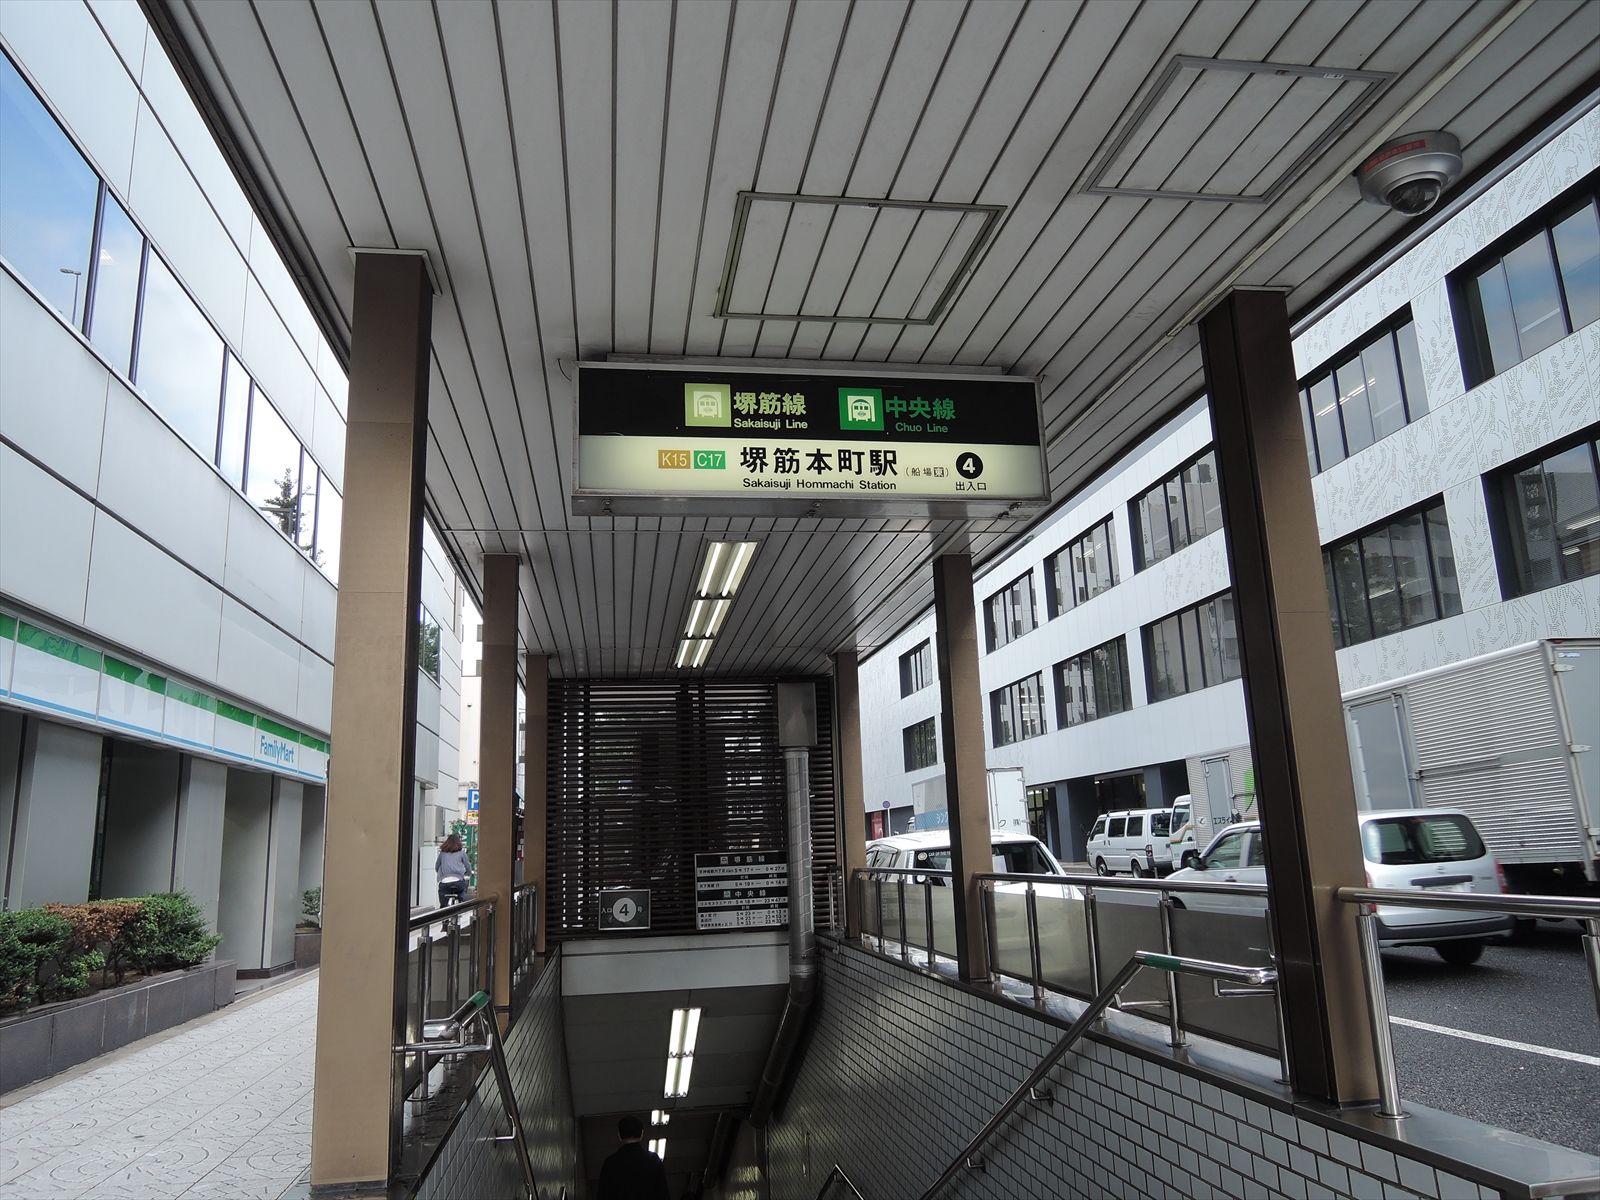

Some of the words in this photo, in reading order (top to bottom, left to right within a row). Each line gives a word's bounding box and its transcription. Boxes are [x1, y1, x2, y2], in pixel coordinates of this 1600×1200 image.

[733, 391, 807, 415] 堺筋線
[885, 396, 956, 419] 中央線
[734, 418, 781, 430] Sakaisuji
[786, 419, 808, 429] Line
[895, 422, 923, 432] Chuo
[927, 423, 948, 433] Line
[661, 453, 688, 467] K15
[697, 453, 723, 467] C17
[740, 446, 898, 476] 堺筋本町駅
[743, 478, 791, 490] Sakaisuji
[796, 478, 854, 490] Hommachi
[859, 480, 897, 490] Station
[955, 481, 987, 491] 出入口
[260, 735, 294, 763] FamilyMart
[471, 791, 480, 809] P
[1213, 816, 1233, 825] エスライ
[619, 903, 629, 916] 4
